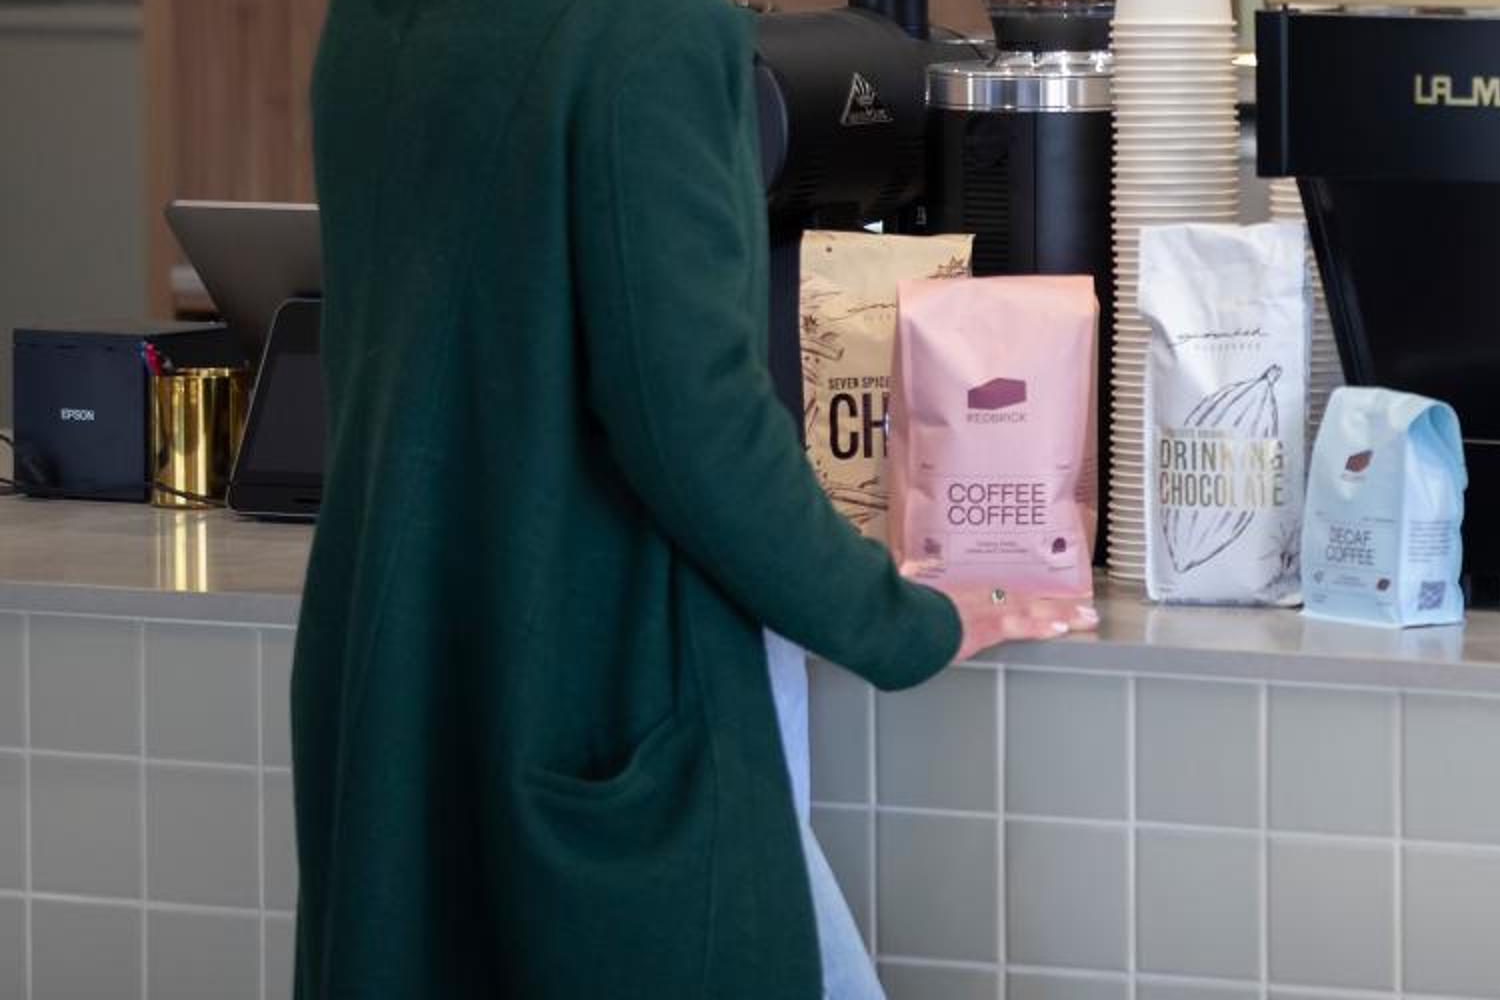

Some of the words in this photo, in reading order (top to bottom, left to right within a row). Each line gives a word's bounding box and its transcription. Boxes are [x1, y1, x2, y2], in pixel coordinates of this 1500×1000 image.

[1414, 74, 1452, 105] LA
[828, 377, 859, 390] SEVEN
[61, 407, 95, 421] EPSON
[1159, 438, 1285, 471] DRINKNG
[947, 483, 1048, 504] COFFEE
[947, 505, 1048, 526] COFFEE
[1329, 525, 1373, 547] DECAF
[1325, 544, 1376, 567] COFFEE
